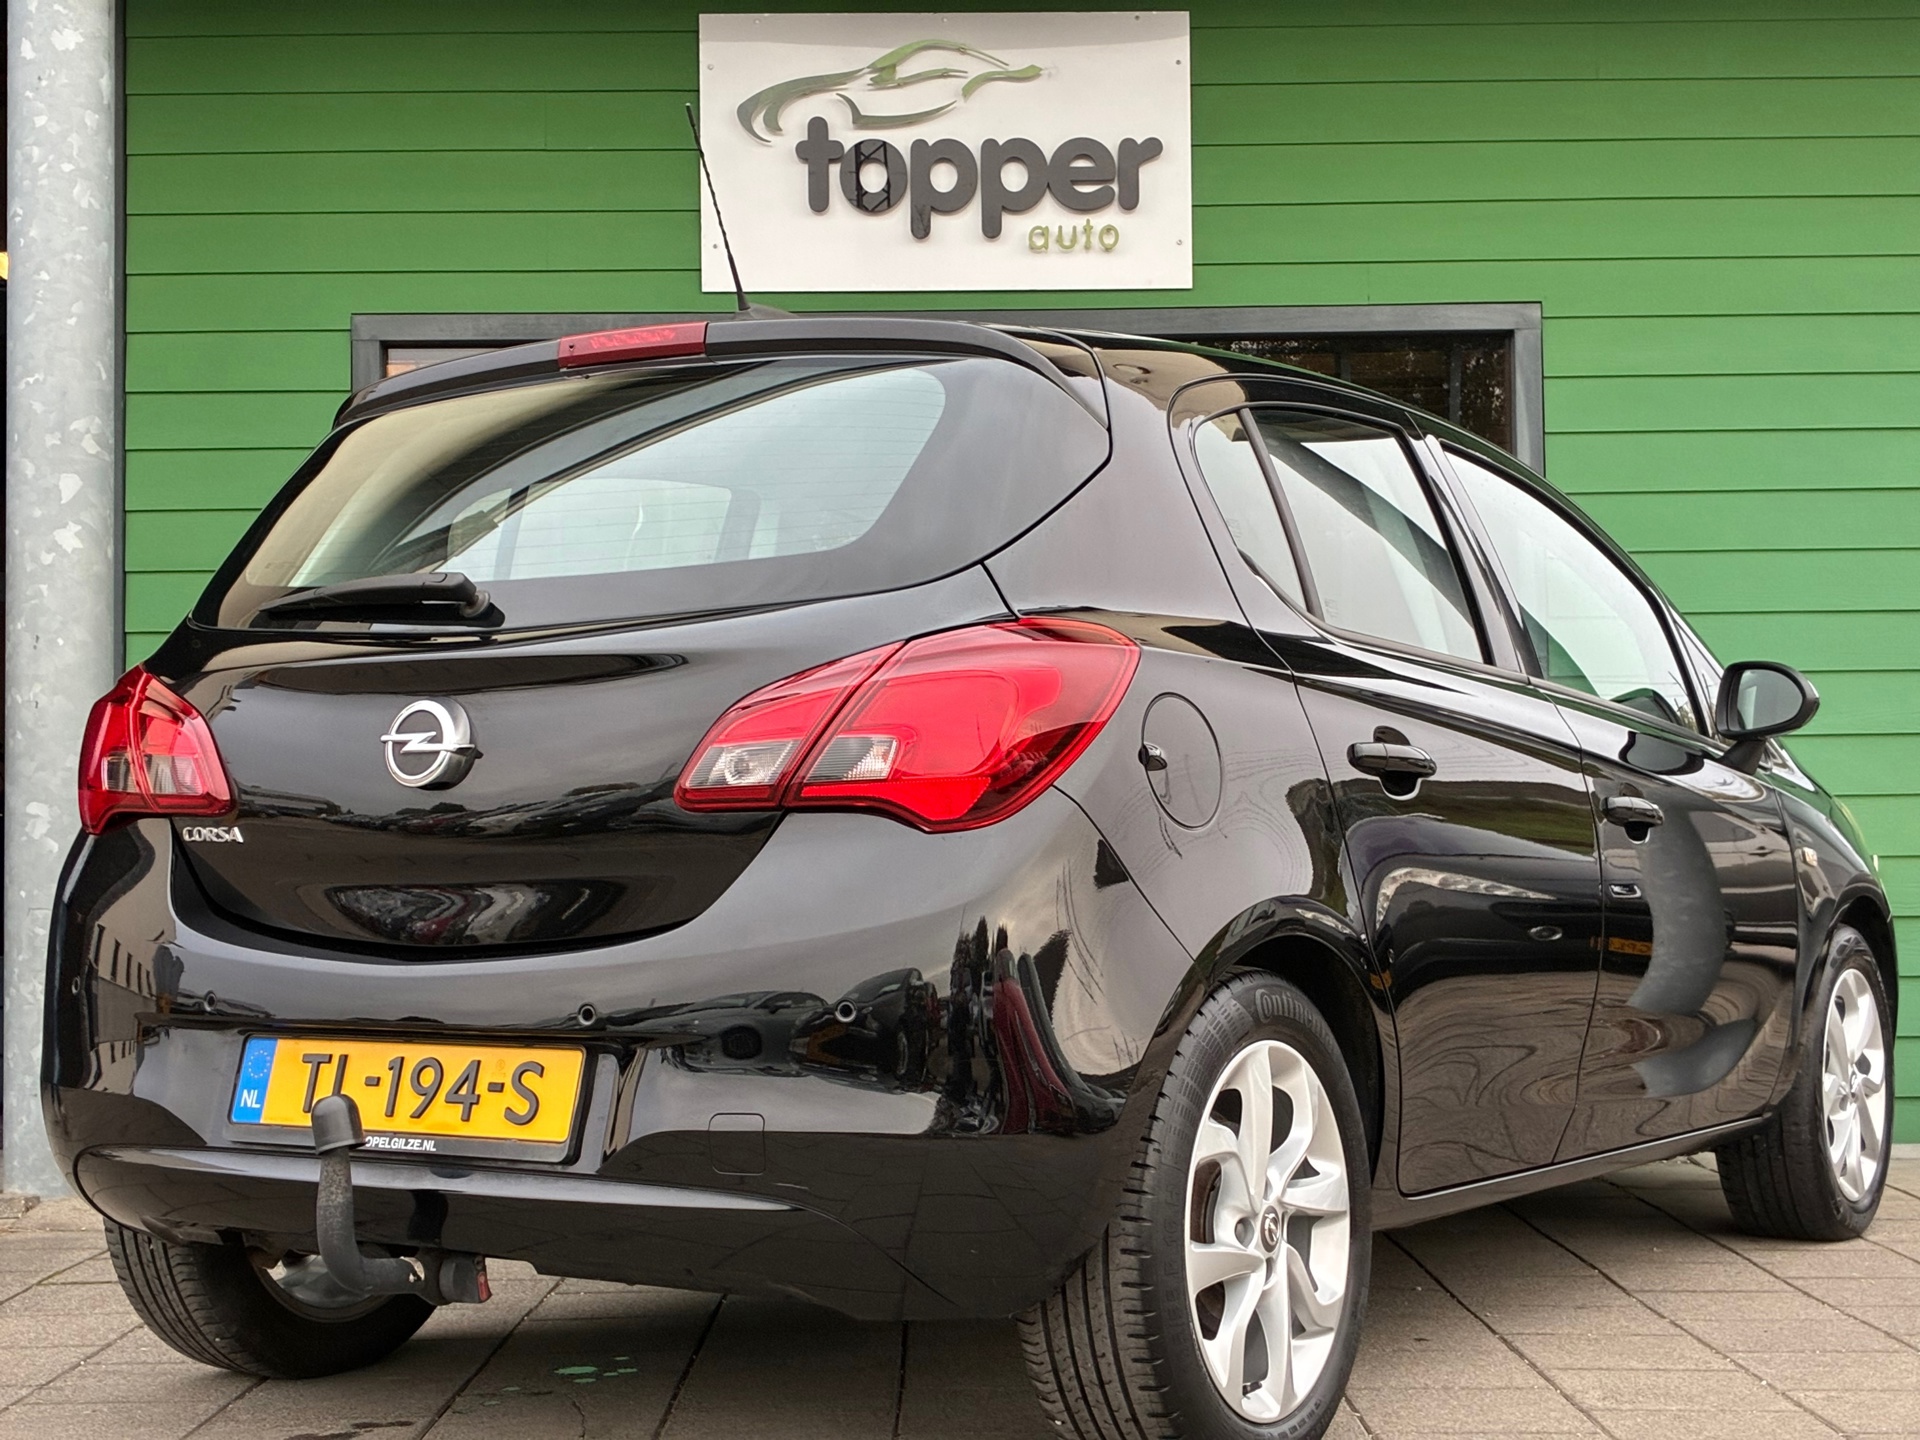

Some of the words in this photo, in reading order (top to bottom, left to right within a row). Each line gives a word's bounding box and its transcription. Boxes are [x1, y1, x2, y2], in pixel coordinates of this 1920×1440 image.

[795, 115, 1164, 240] topper
[1027, 217, 1120, 252] auto
[182, 826, 244, 843] CORSA
[240, 1089, 262, 1109] NL
[365, 1135, 437, 1152] OPELGILZE.NL
